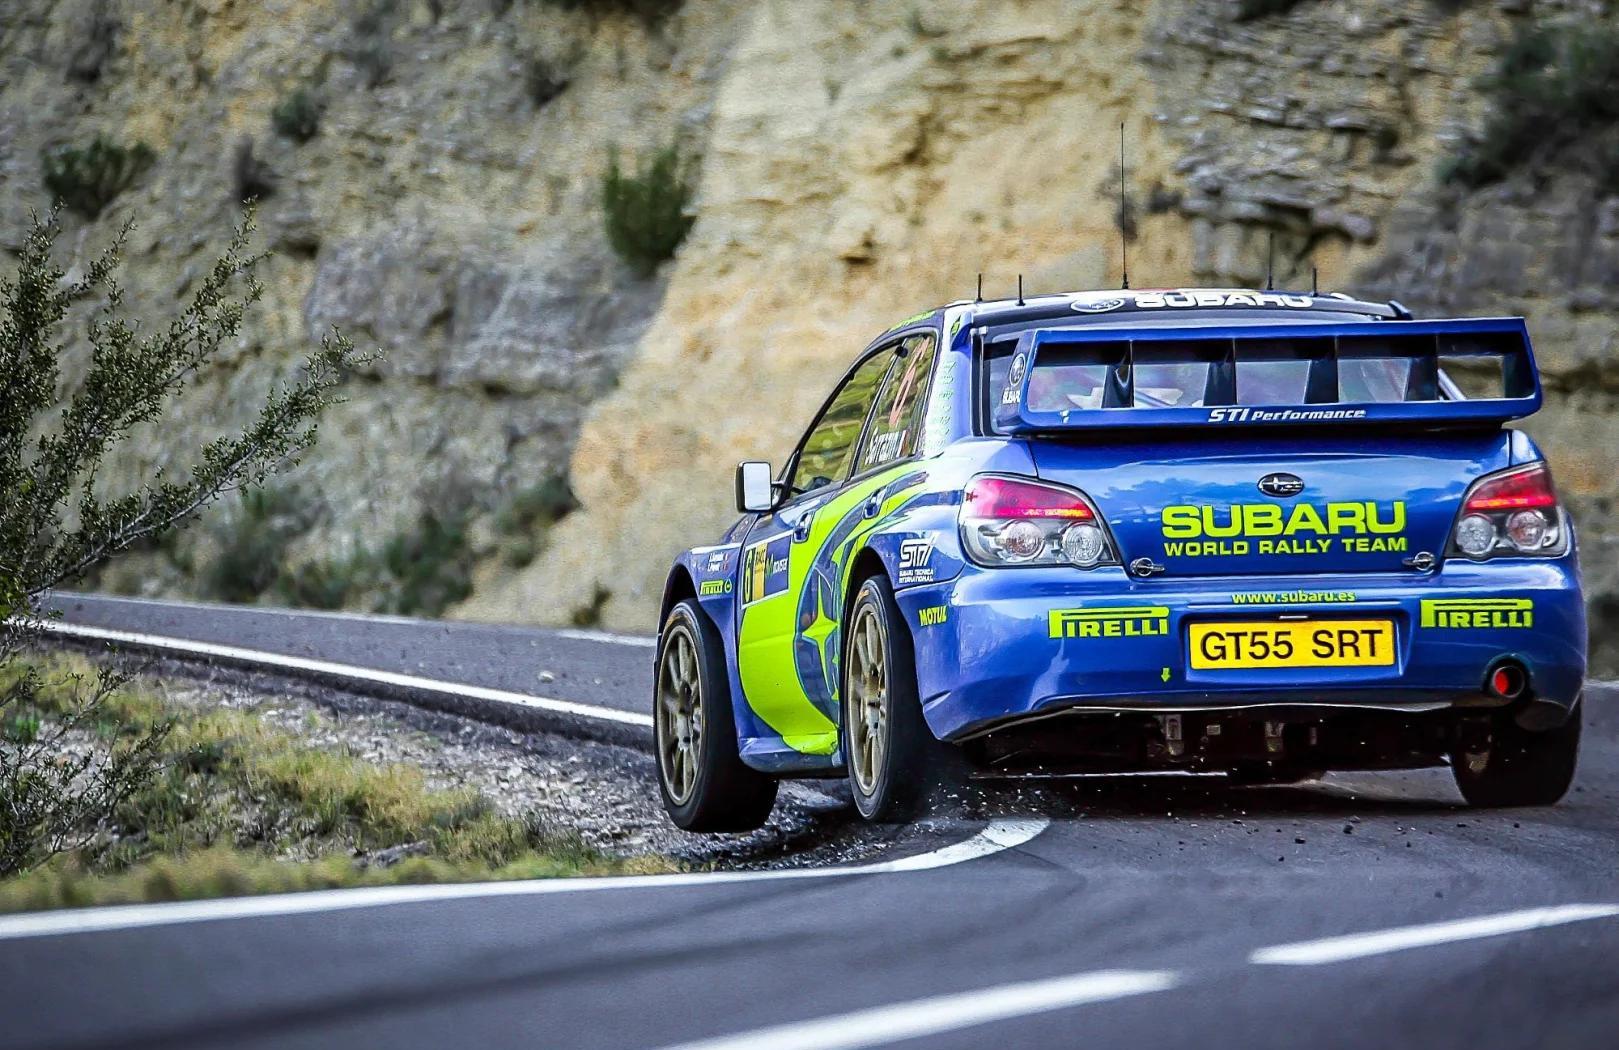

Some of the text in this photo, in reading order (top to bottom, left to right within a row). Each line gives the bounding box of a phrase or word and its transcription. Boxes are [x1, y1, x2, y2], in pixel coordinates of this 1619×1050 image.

[1135, 293, 1313, 308] SUBARU
[1208, 408, 1367, 422] STI Performance
[1162, 501, 1406, 538] SUBARU
[1164, 537, 1406, 556] WORLD RALLY TEAM
[1232, 590, 1356, 604] www.subaru.es
[919, 605, 947, 627] MOTUL
[1048, 606, 1170, 638] PIRELLI
[1420, 599, 1534, 628] PIRELLI
[1202, 629, 1384, 661] GT55 SRT
